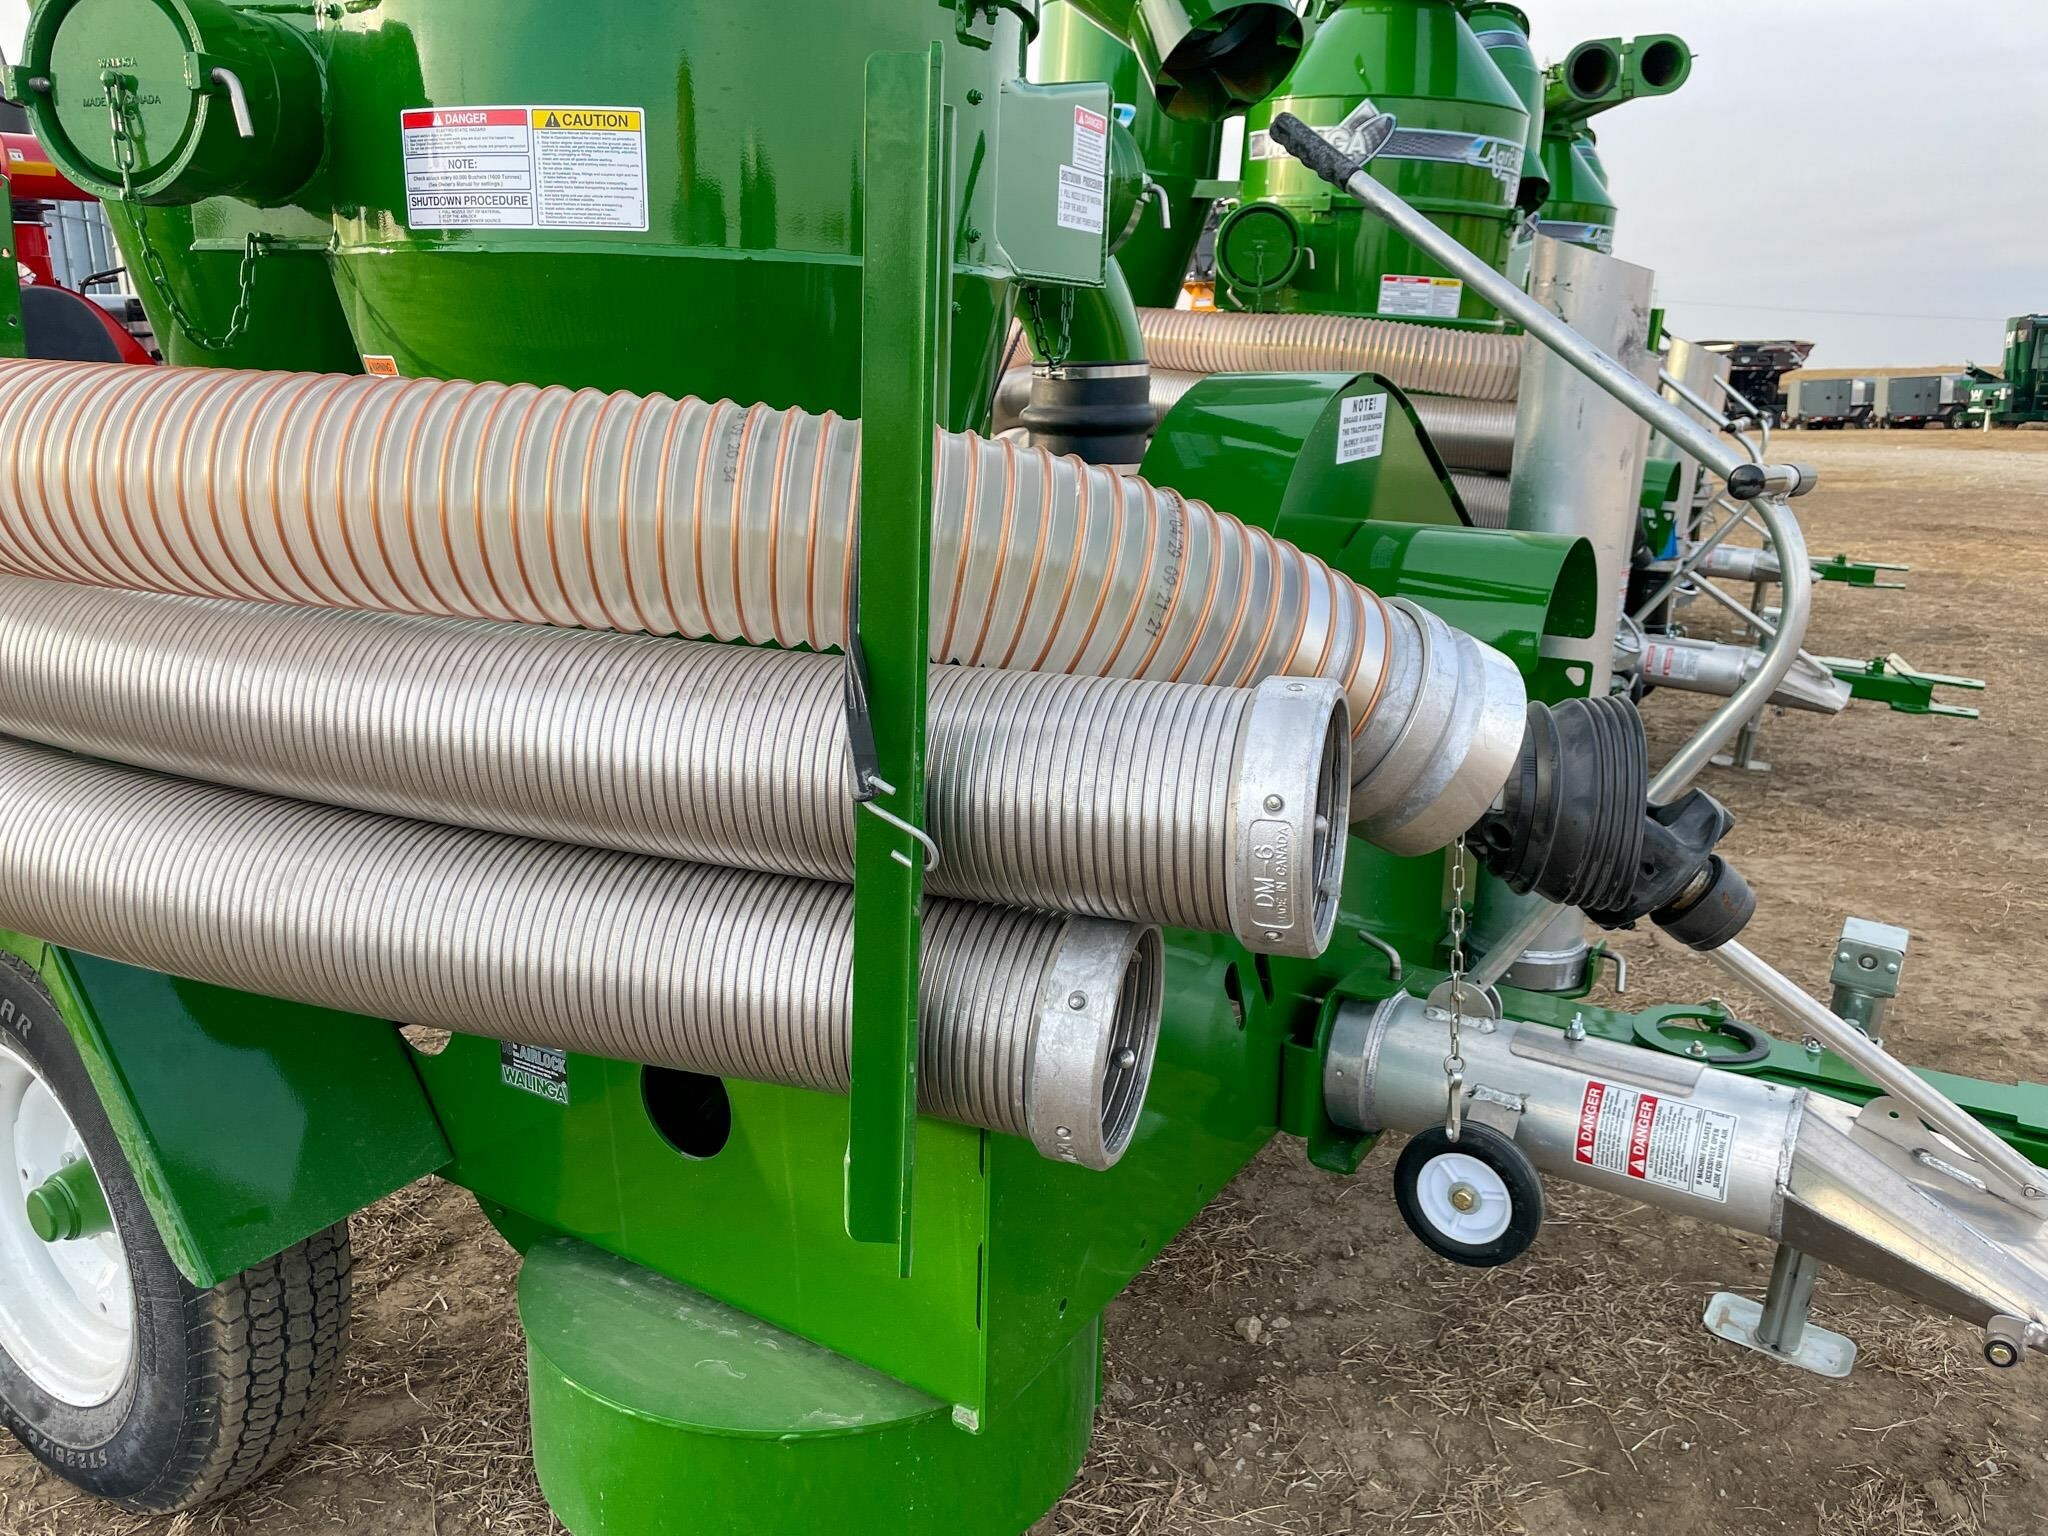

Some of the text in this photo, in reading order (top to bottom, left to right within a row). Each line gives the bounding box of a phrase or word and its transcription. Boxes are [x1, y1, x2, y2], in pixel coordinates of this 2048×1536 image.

[445, 112, 487, 125] DANGER
[562, 113, 629, 128] CAUTION
[448, 158, 478, 170] NOTE:
[411, 195, 529, 207] SHUTDOWN PROCEDURE
[1352, 397, 1377, 413] NOTE!
[1275, 826, 1289, 876] CANADA
[1275, 881, 1288, 892] IN
[502, 1064, 569, 1104] WALINGA
[1580, 1087, 1602, 1142] DANGER
[1632, 1100, 1655, 1156] DANGER
